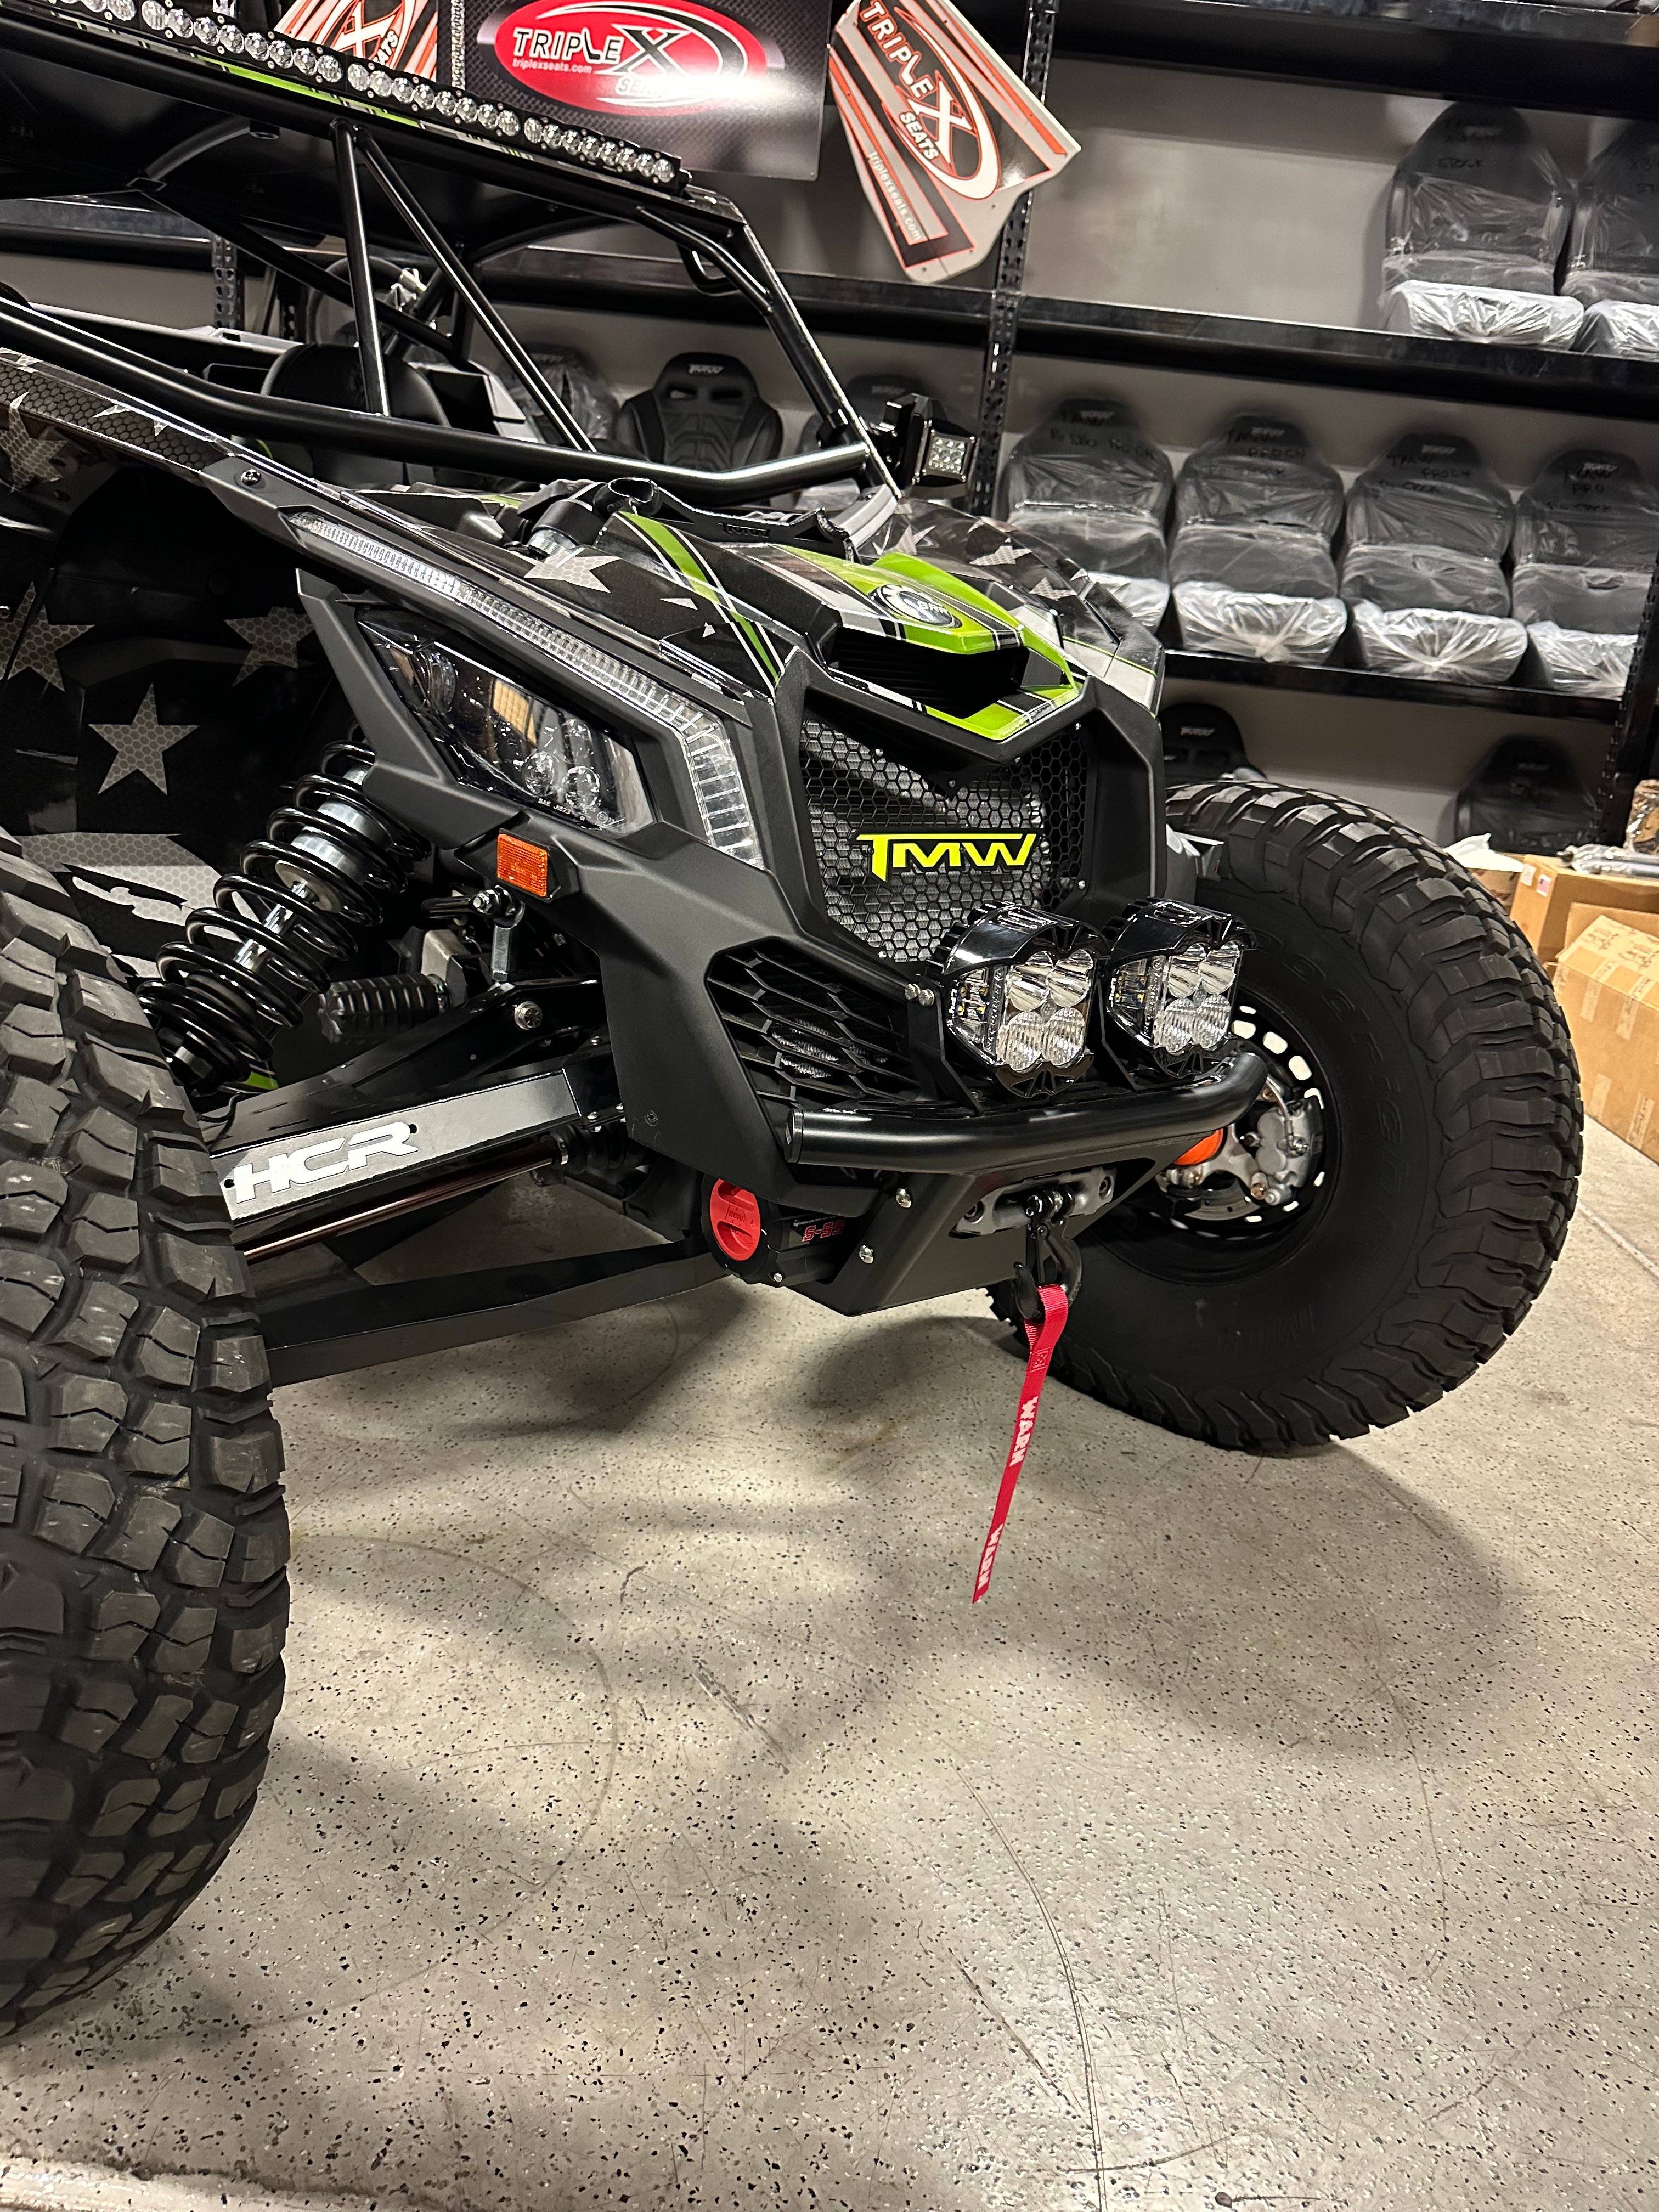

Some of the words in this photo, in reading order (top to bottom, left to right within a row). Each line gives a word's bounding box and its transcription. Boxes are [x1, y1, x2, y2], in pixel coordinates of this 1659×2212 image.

[373, 30, 399, 65] ATS
[512, 59, 592, 74] triplexseats.com
[899, 111, 940, 159] SEATS
[868, 151, 923, 240] triplexseats.com
[856, 833, 1037, 882] TMW
[233, 1121, 420, 1204] HCR
[1009, 1395, 1039, 1468] WARN
[977, 1522, 1004, 1591] WARN
